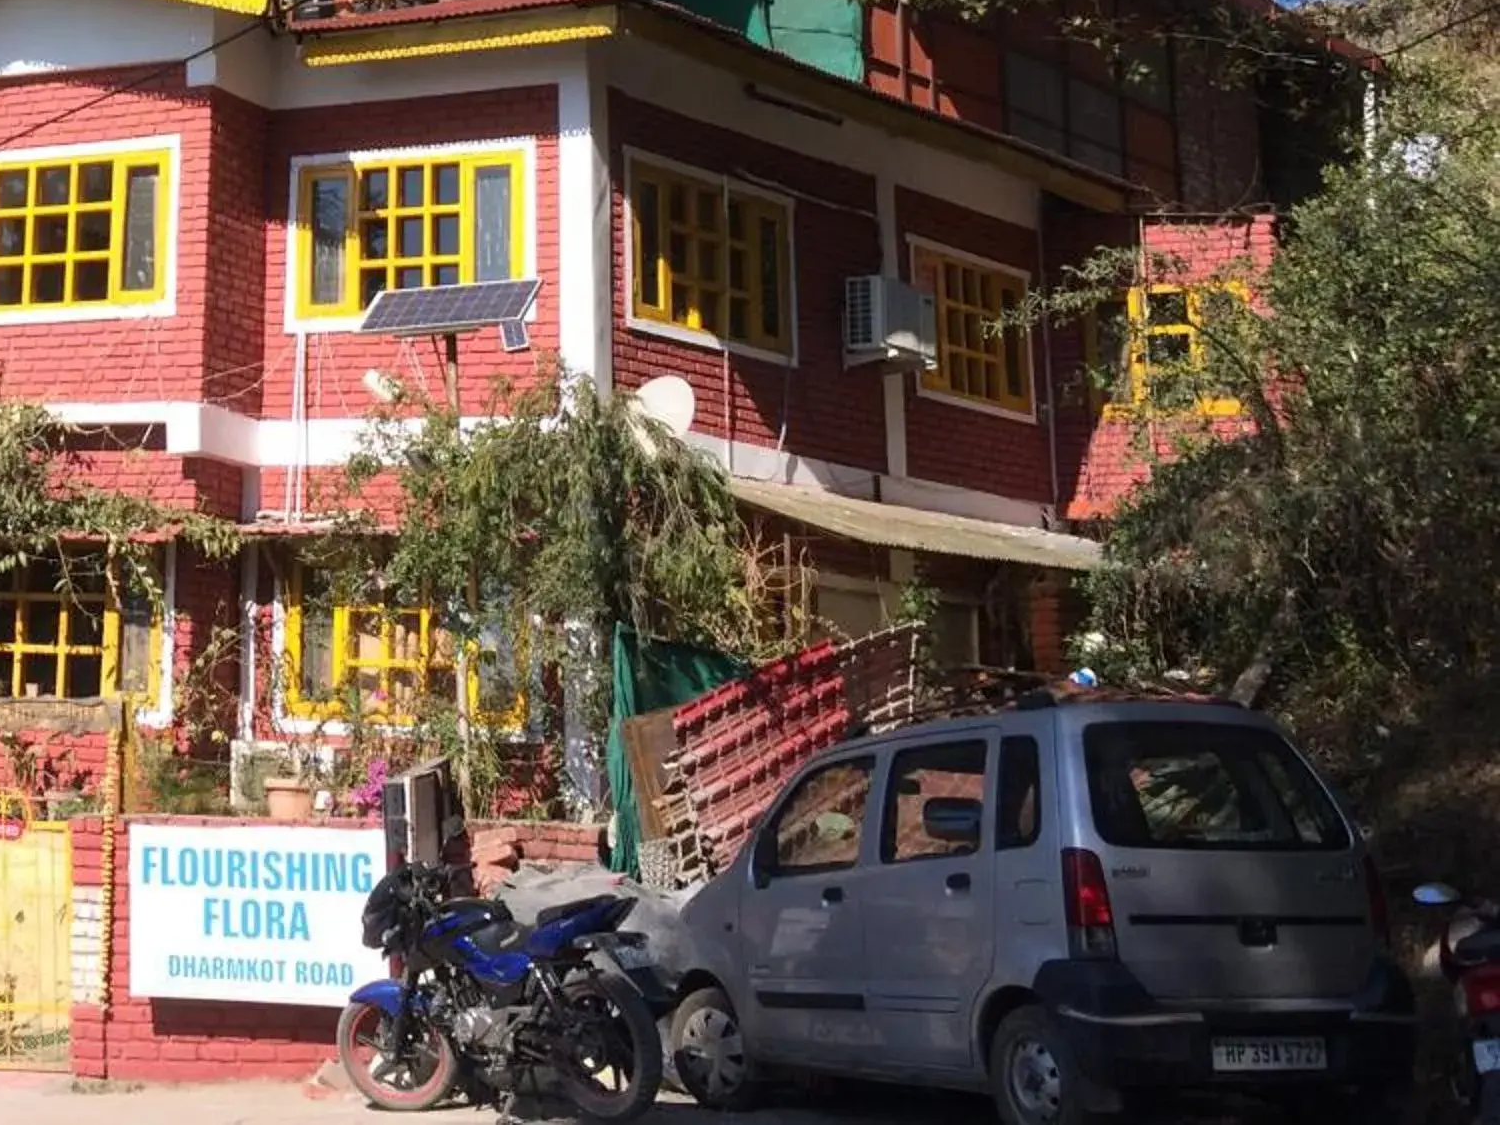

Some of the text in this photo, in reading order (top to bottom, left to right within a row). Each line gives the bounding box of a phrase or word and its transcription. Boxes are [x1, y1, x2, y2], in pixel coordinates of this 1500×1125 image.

[142, 846, 373, 893] FLOURISHING
[204, 897, 310, 941] FLORA
[168, 954, 354, 986] DHARMKOT ROAD
